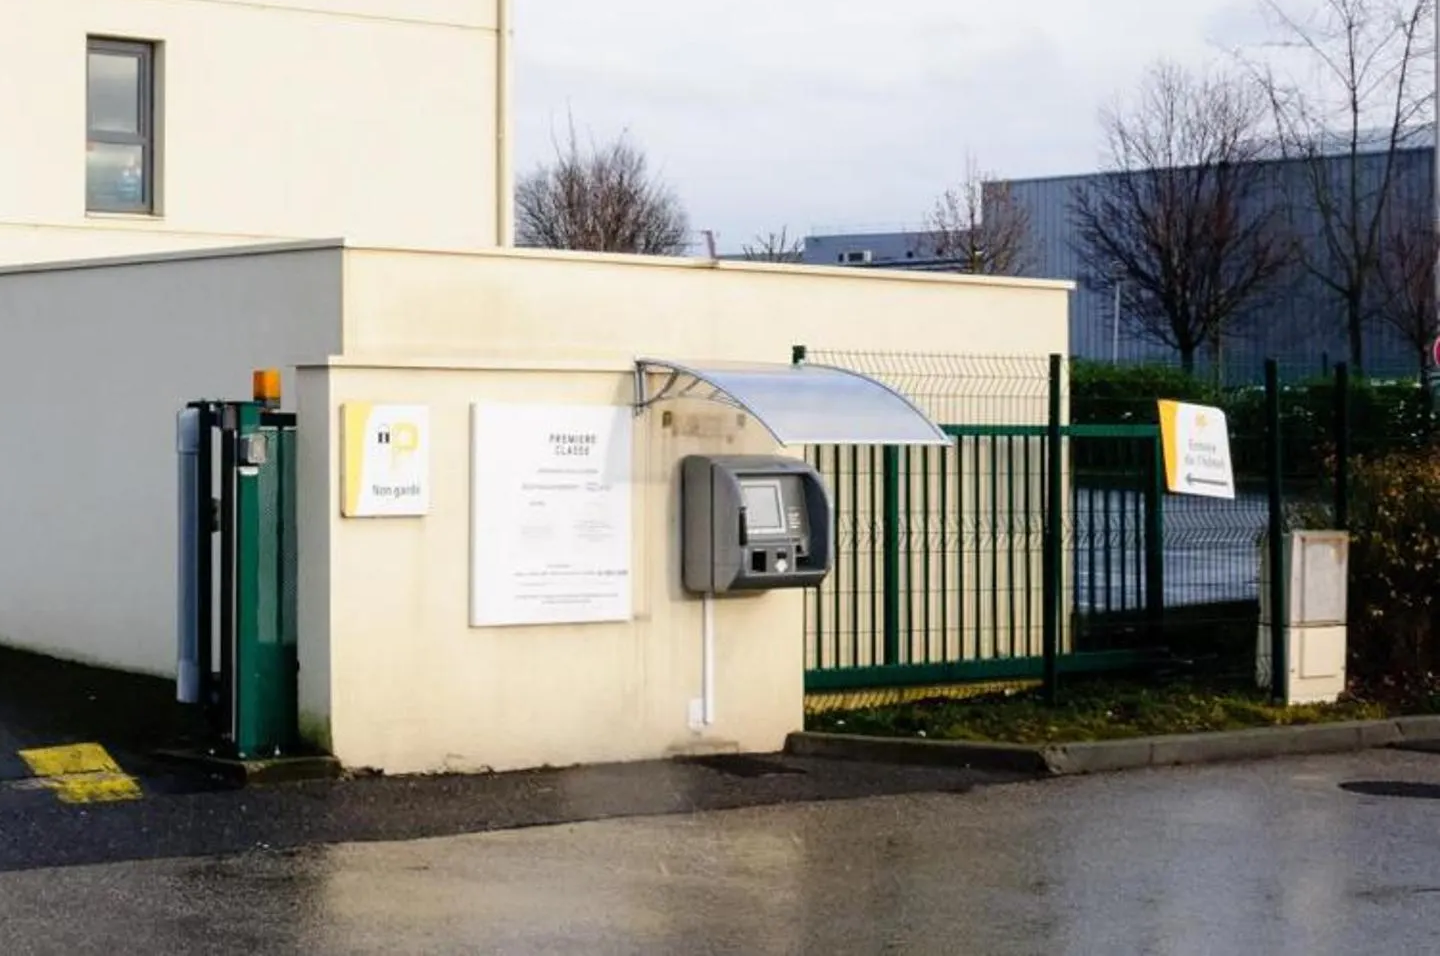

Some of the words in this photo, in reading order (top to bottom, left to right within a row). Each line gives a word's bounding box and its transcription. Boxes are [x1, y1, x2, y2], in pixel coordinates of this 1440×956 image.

[549, 433, 597, 444] PREMIERE
[555, 444, 590, 456] CLASSE
[372, 484, 392, 496] Non
